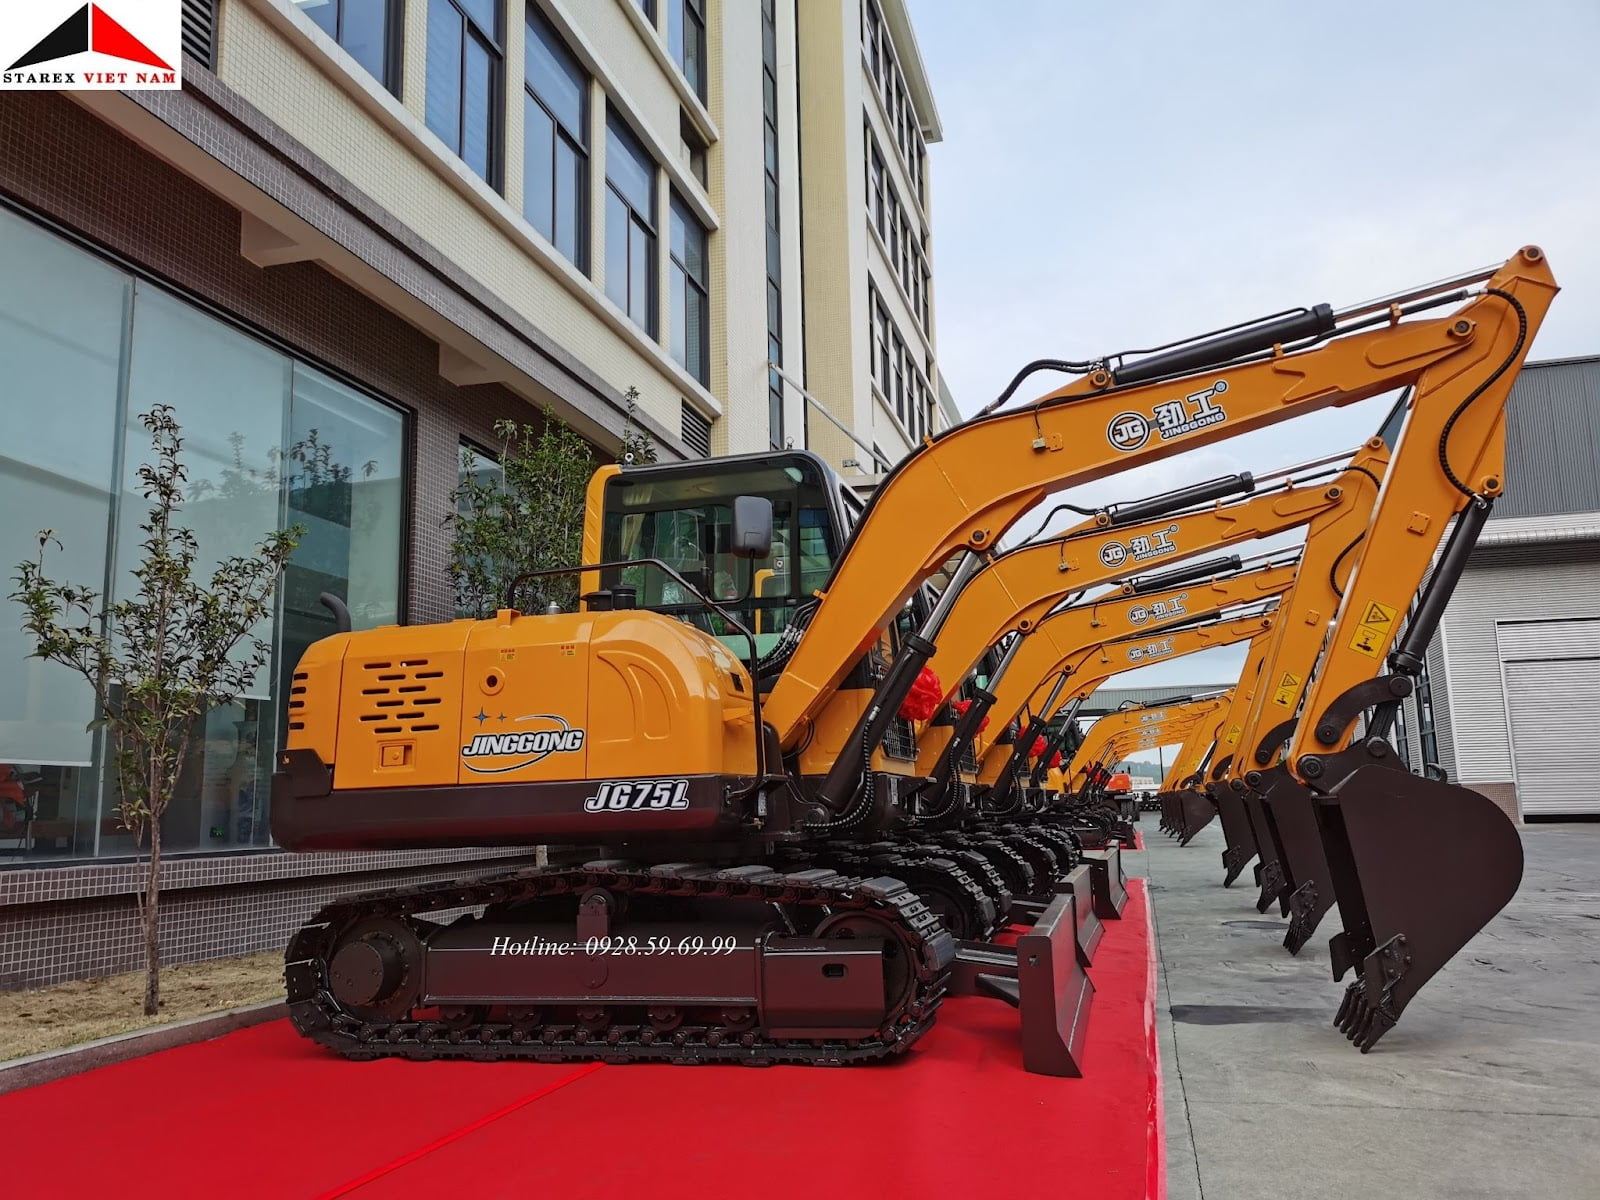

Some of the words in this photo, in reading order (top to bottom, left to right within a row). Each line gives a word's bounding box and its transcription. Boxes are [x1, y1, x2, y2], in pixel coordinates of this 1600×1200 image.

[1154, 388, 1221, 431] 劲工
[1111, 418, 1147, 445] JG
[1161, 412, 1225, 439] JINGGONG
[462, 730, 584, 757] JINGGONG
[585, 780, 689, 812] JG75L
